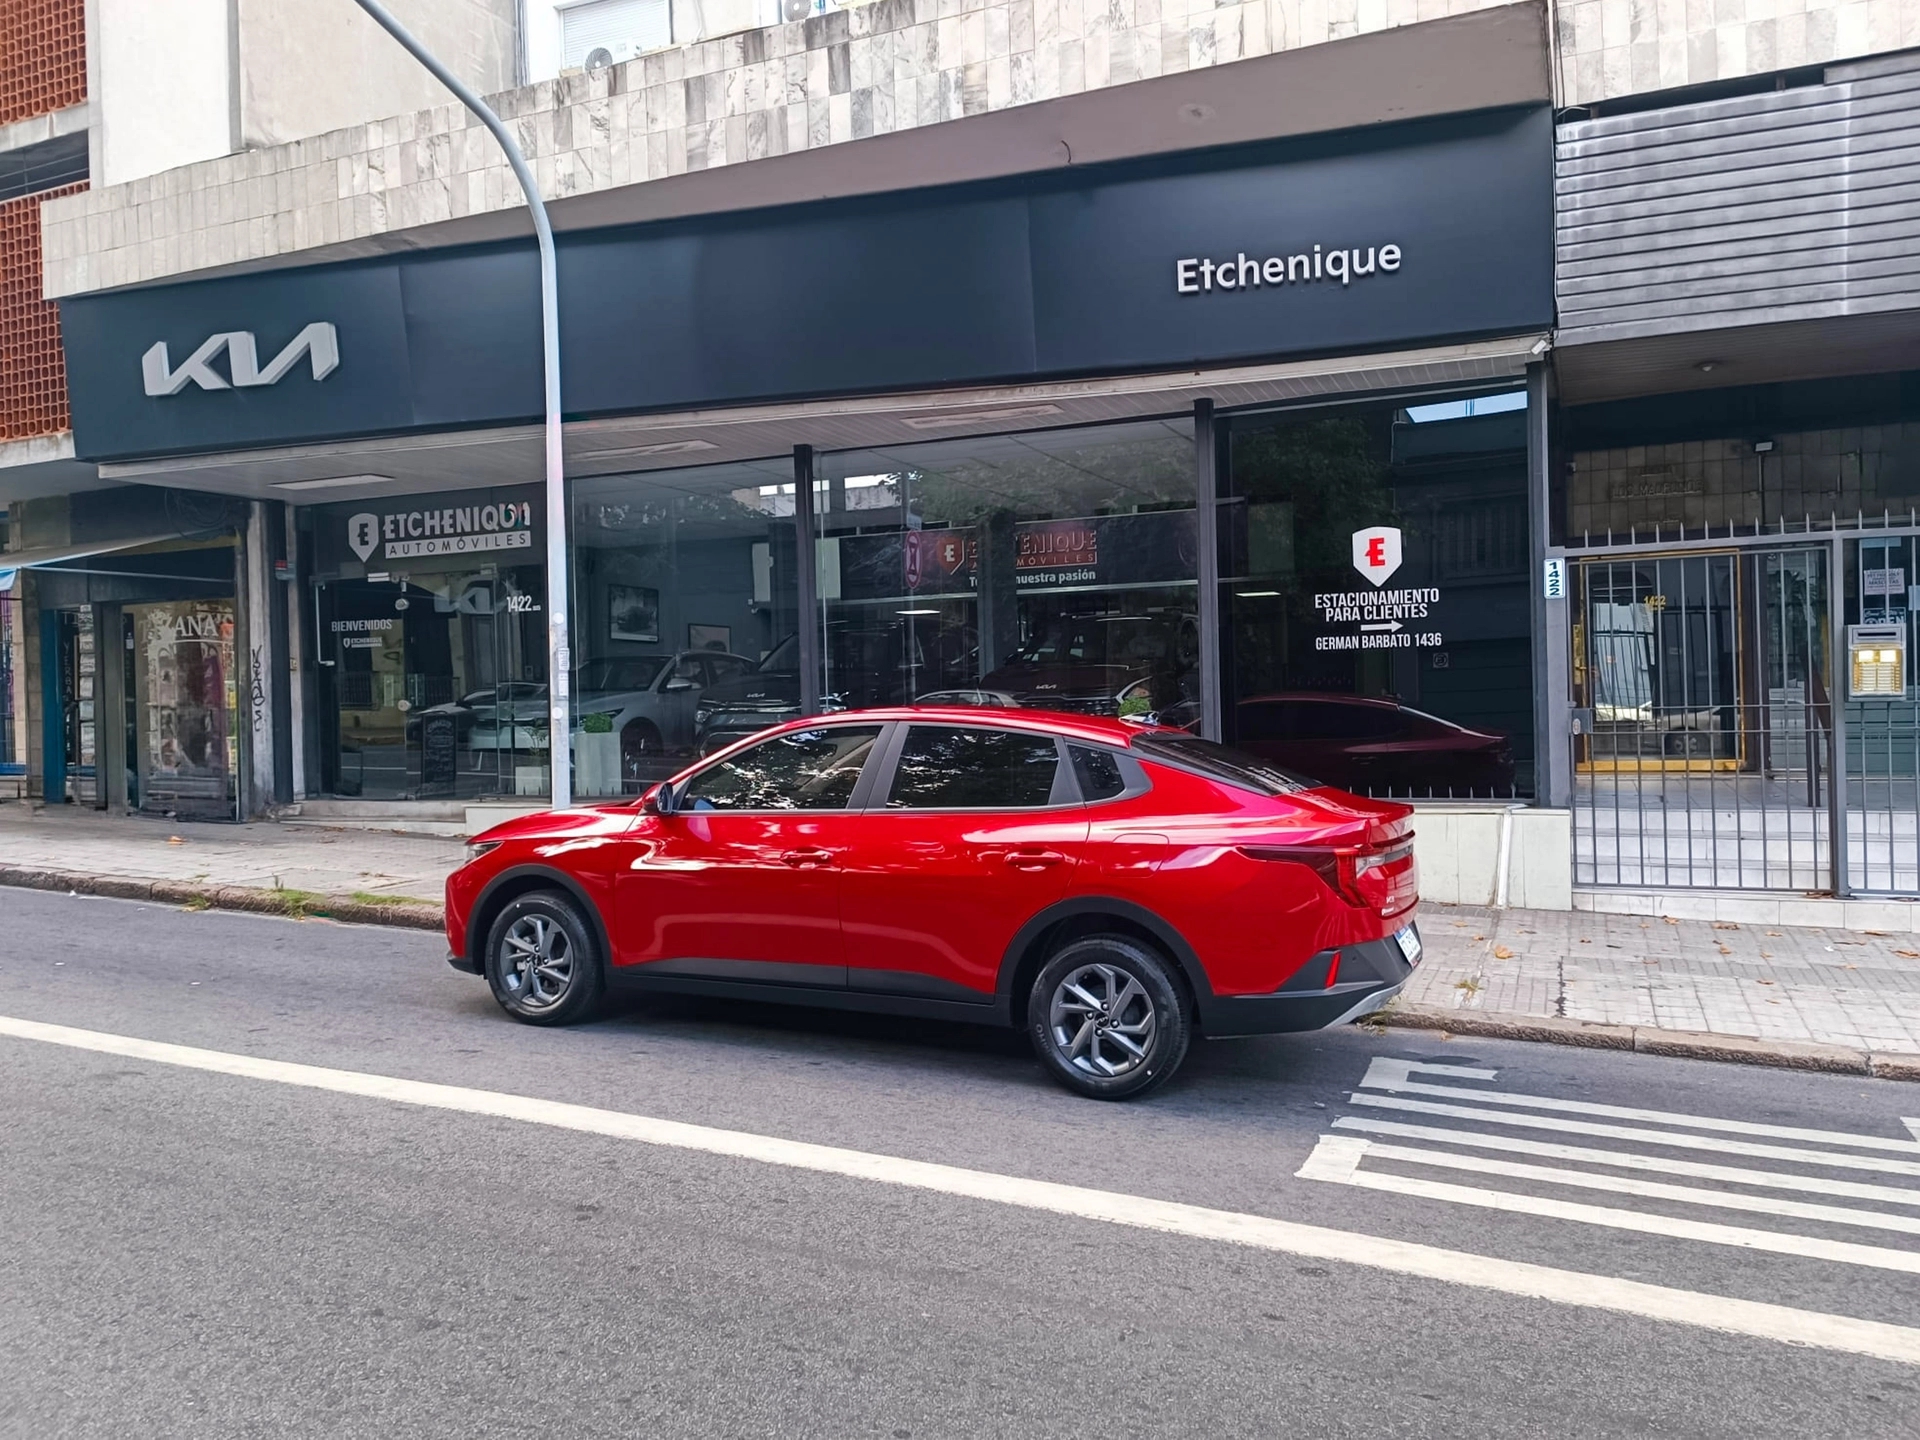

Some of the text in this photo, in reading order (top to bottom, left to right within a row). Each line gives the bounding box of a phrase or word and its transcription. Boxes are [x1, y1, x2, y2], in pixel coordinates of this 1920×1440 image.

[1177, 244, 1401, 293] Etchenique
[142, 322, 339, 396] KIA
[389, 533, 526, 556] AUTOMÓVILES
[1059, 569, 1096, 584] pasión
[1548, 562, 1560, 596] 1422
[506, 595, 532, 613] 1422
[1314, 588, 1440, 608] ESTACIONAMIENTO
[1326, 603, 1428, 622] PARA CLIENTES
[331, 619, 392, 632] BIENVENIDOS
[1315, 633, 1442, 650] GERMAN BARBATO 1436
